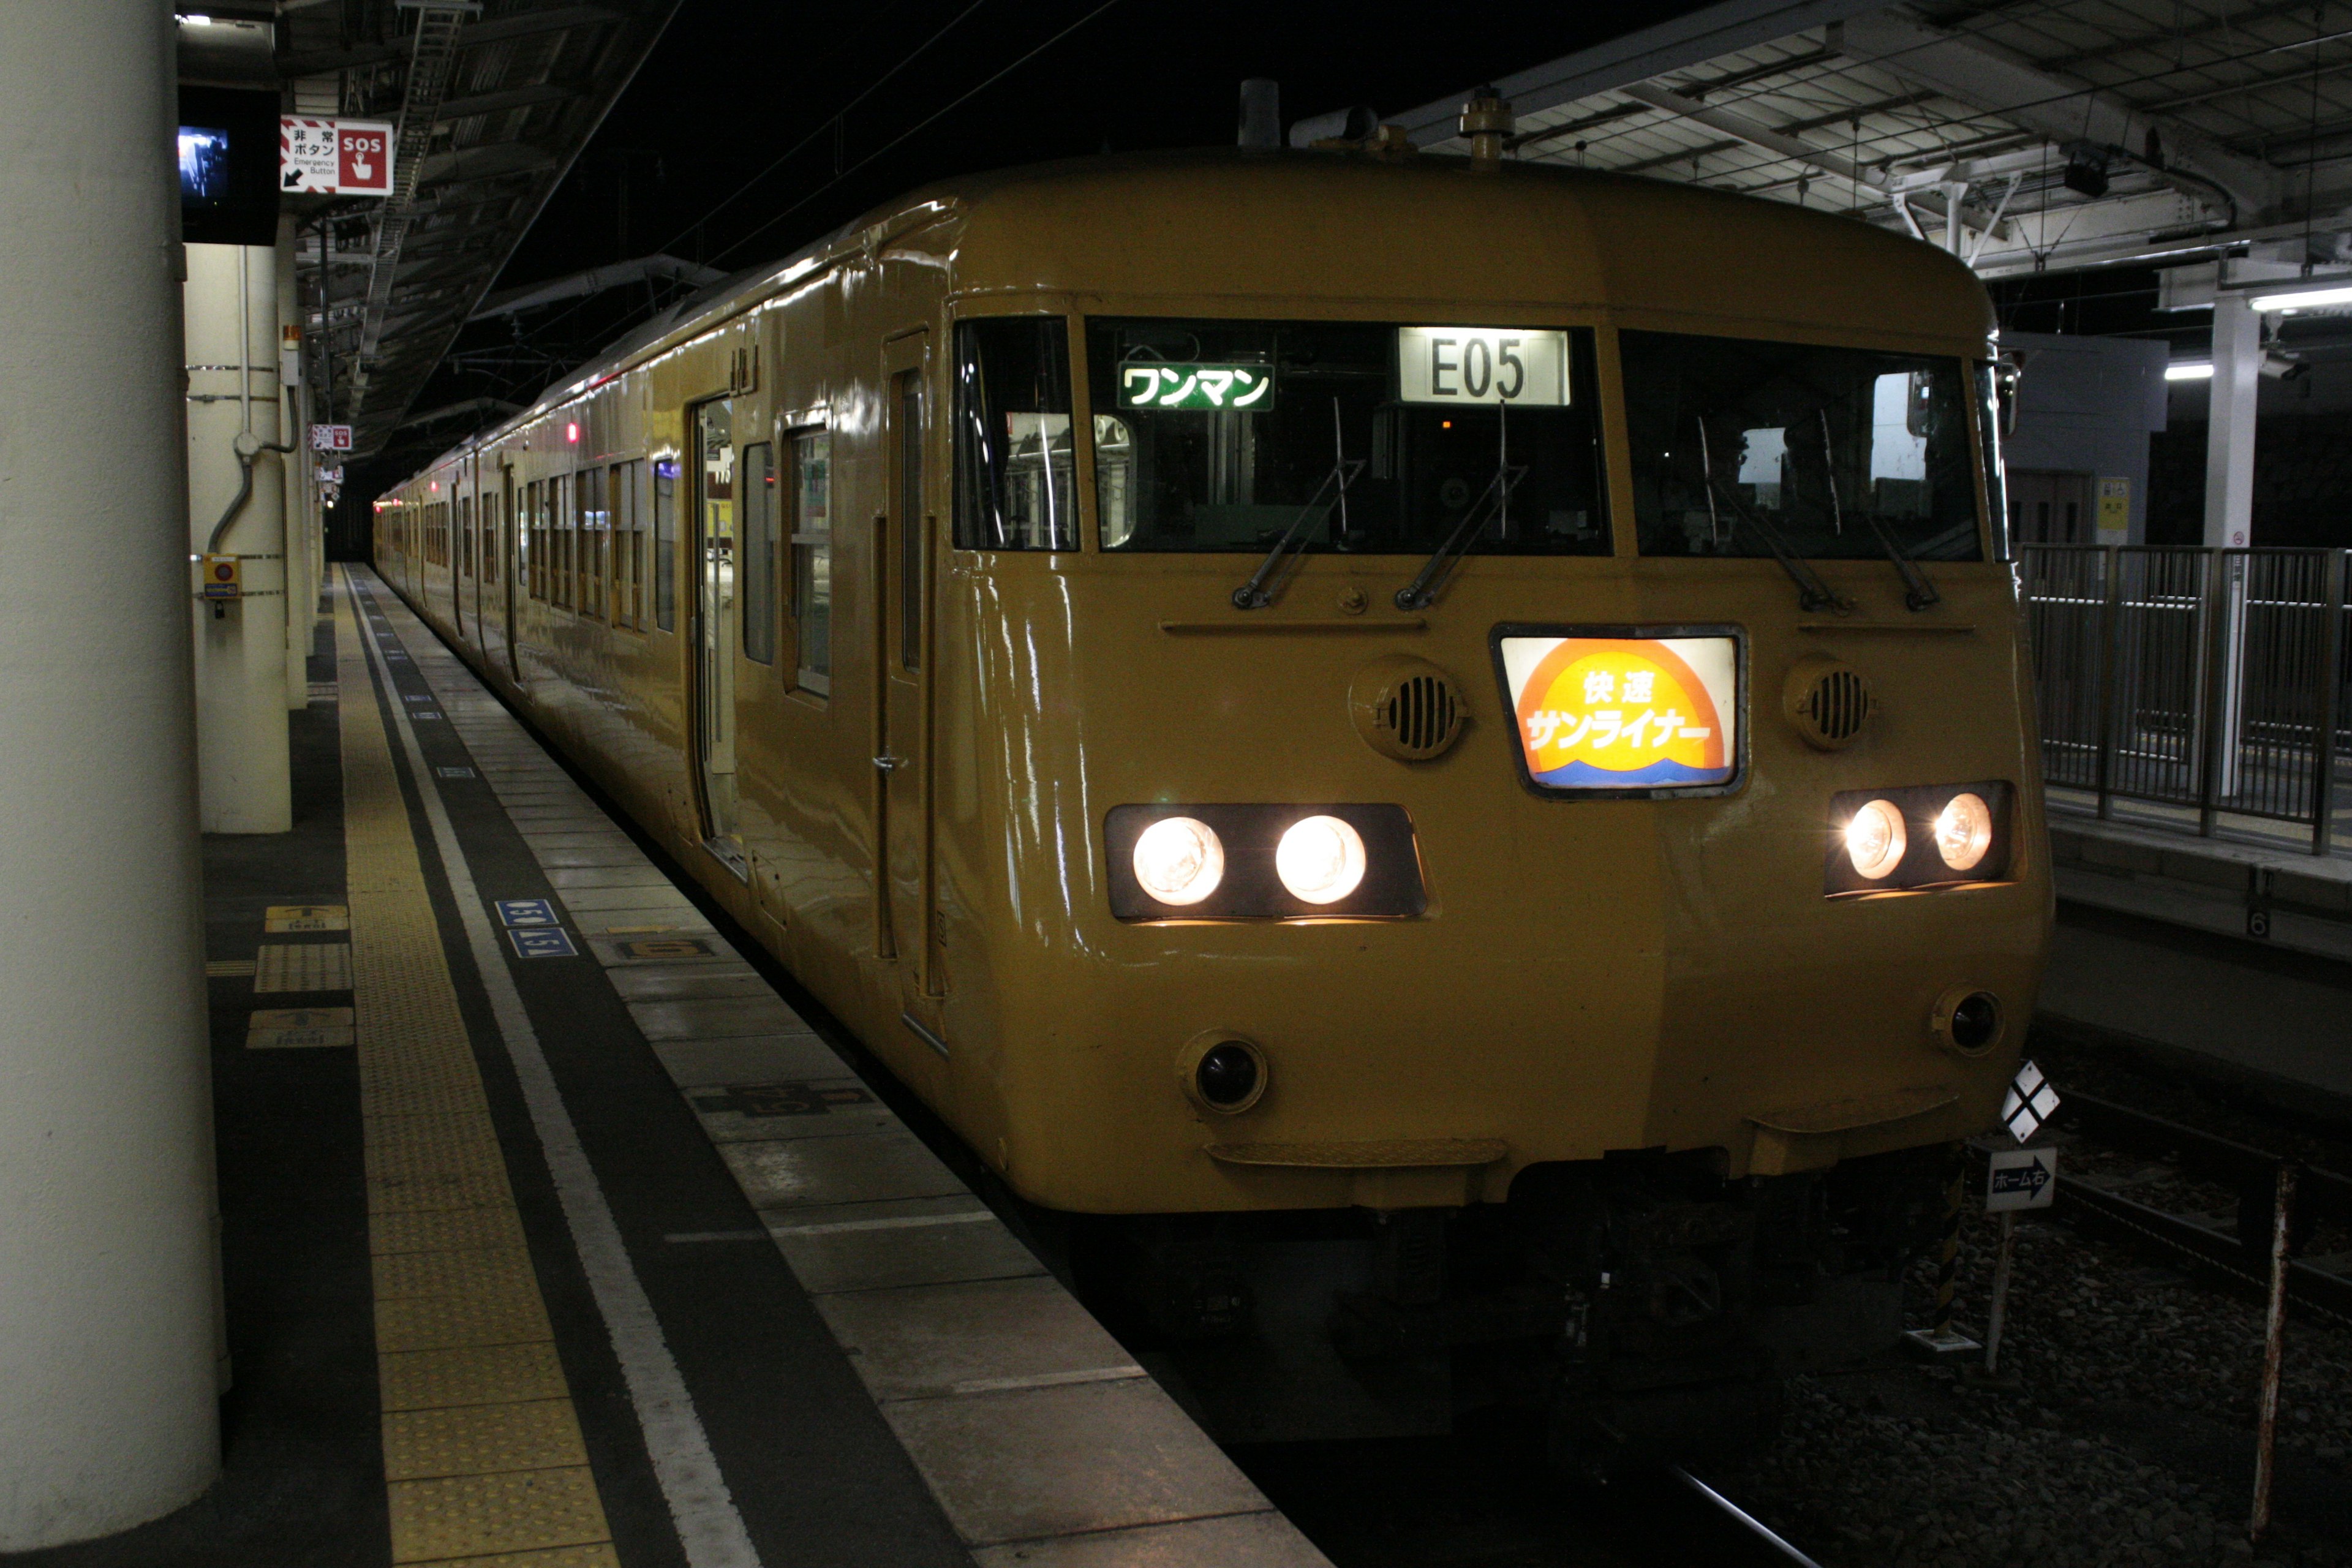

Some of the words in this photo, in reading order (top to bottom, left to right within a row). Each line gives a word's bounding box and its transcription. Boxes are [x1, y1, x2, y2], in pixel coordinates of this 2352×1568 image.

[294, 129, 334, 143] 非常
[344, 137, 381, 153] SOS
[295, 143, 334, 156] ボタン
[294, 157, 334, 167] Emergency
[310, 167, 335, 175] Button
[1431, 337, 1524, 399] E05
[1124, 368, 1269, 407] ワンマン
[1583, 671, 1655, 704] 快速
[1526, 708, 1711, 750] サンライナー
[2250, 912, 2267, 935] 6
[1995, 1170, 2045, 1189] ホーム右
